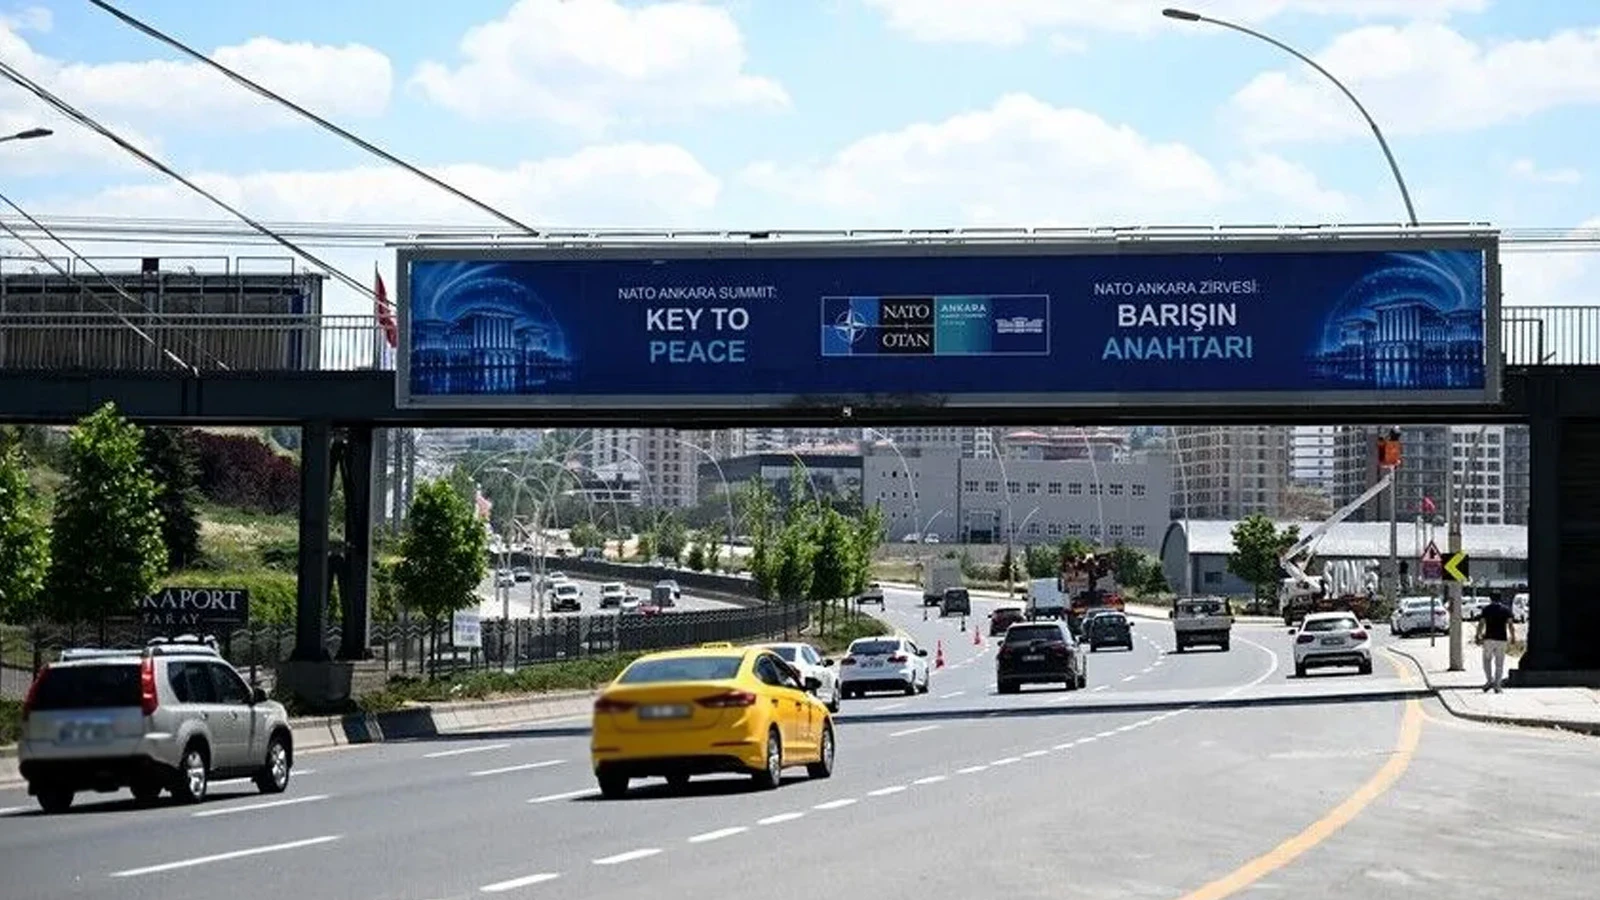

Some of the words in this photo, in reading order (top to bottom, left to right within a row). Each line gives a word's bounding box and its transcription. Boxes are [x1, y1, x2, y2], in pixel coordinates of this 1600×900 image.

[618, 287, 656, 299] NATO
[658, 286, 716, 299] ANKARA
[719, 286, 777, 299] SUMMIT:
[1094, 282, 1133, 295] NATO
[1136, 281, 1196, 295] ANKARA
[883, 304, 930, 319] NATO
[941, 303, 987, 312] ANKARA
[647, 308, 703, 331] KEY
[710, 307, 749, 331] TO
[1118, 303, 1236, 331] BARIŞIN
[882, 333, 929, 348] OTAN
[1102, 336, 1253, 360] ANAHTARI
[649, 340, 746, 363] PEACE
